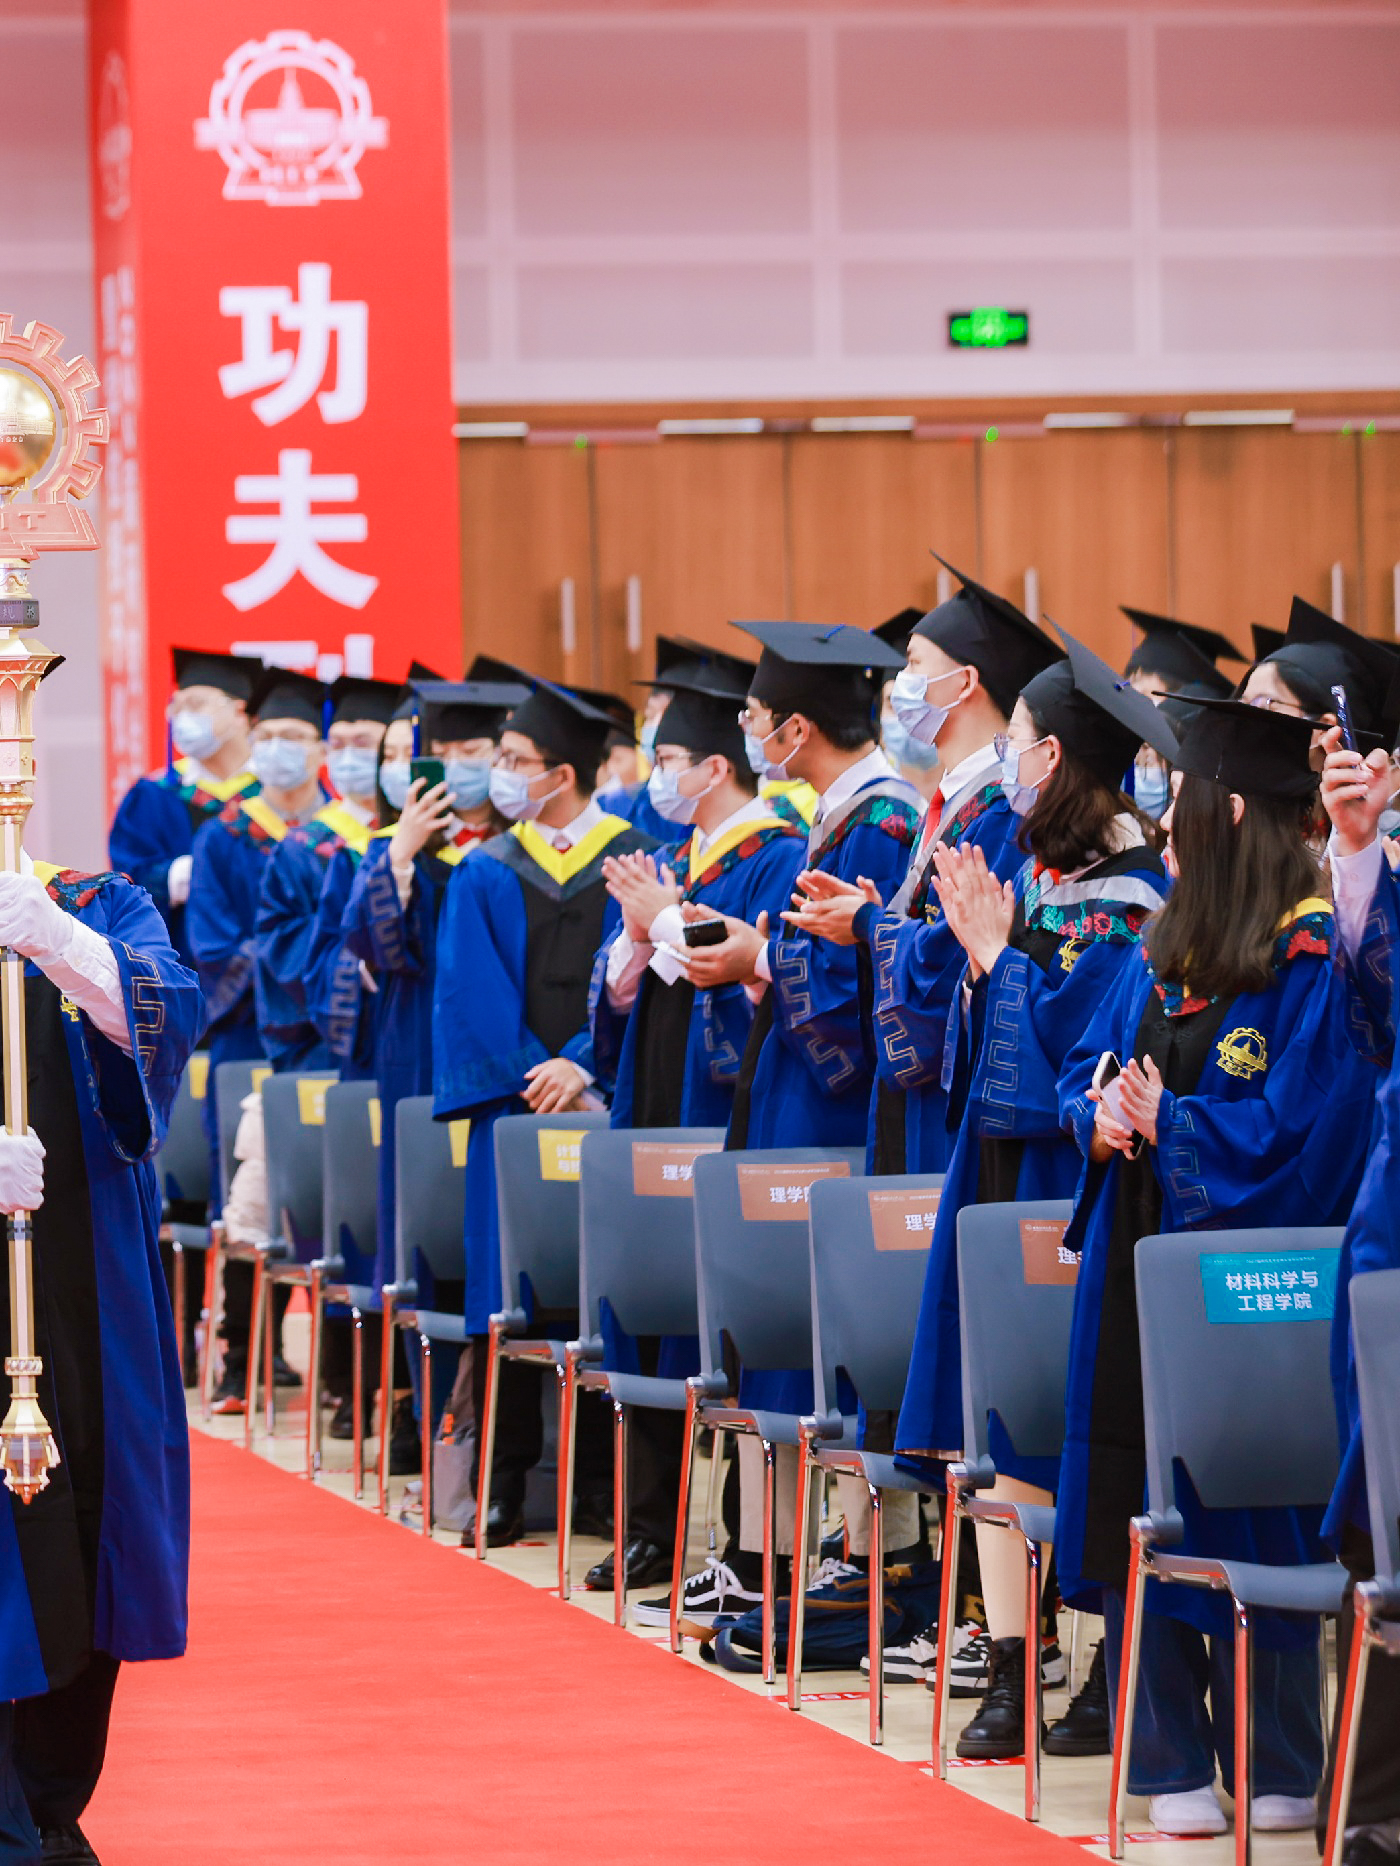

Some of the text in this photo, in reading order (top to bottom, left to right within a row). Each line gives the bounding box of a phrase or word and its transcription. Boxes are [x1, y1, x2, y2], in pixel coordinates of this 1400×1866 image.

[1056, 1246, 1083, 1265] 理
[1225, 1270, 1319, 1291] 材料科学与
[1237, 1292, 1313, 1312] 工程学院
